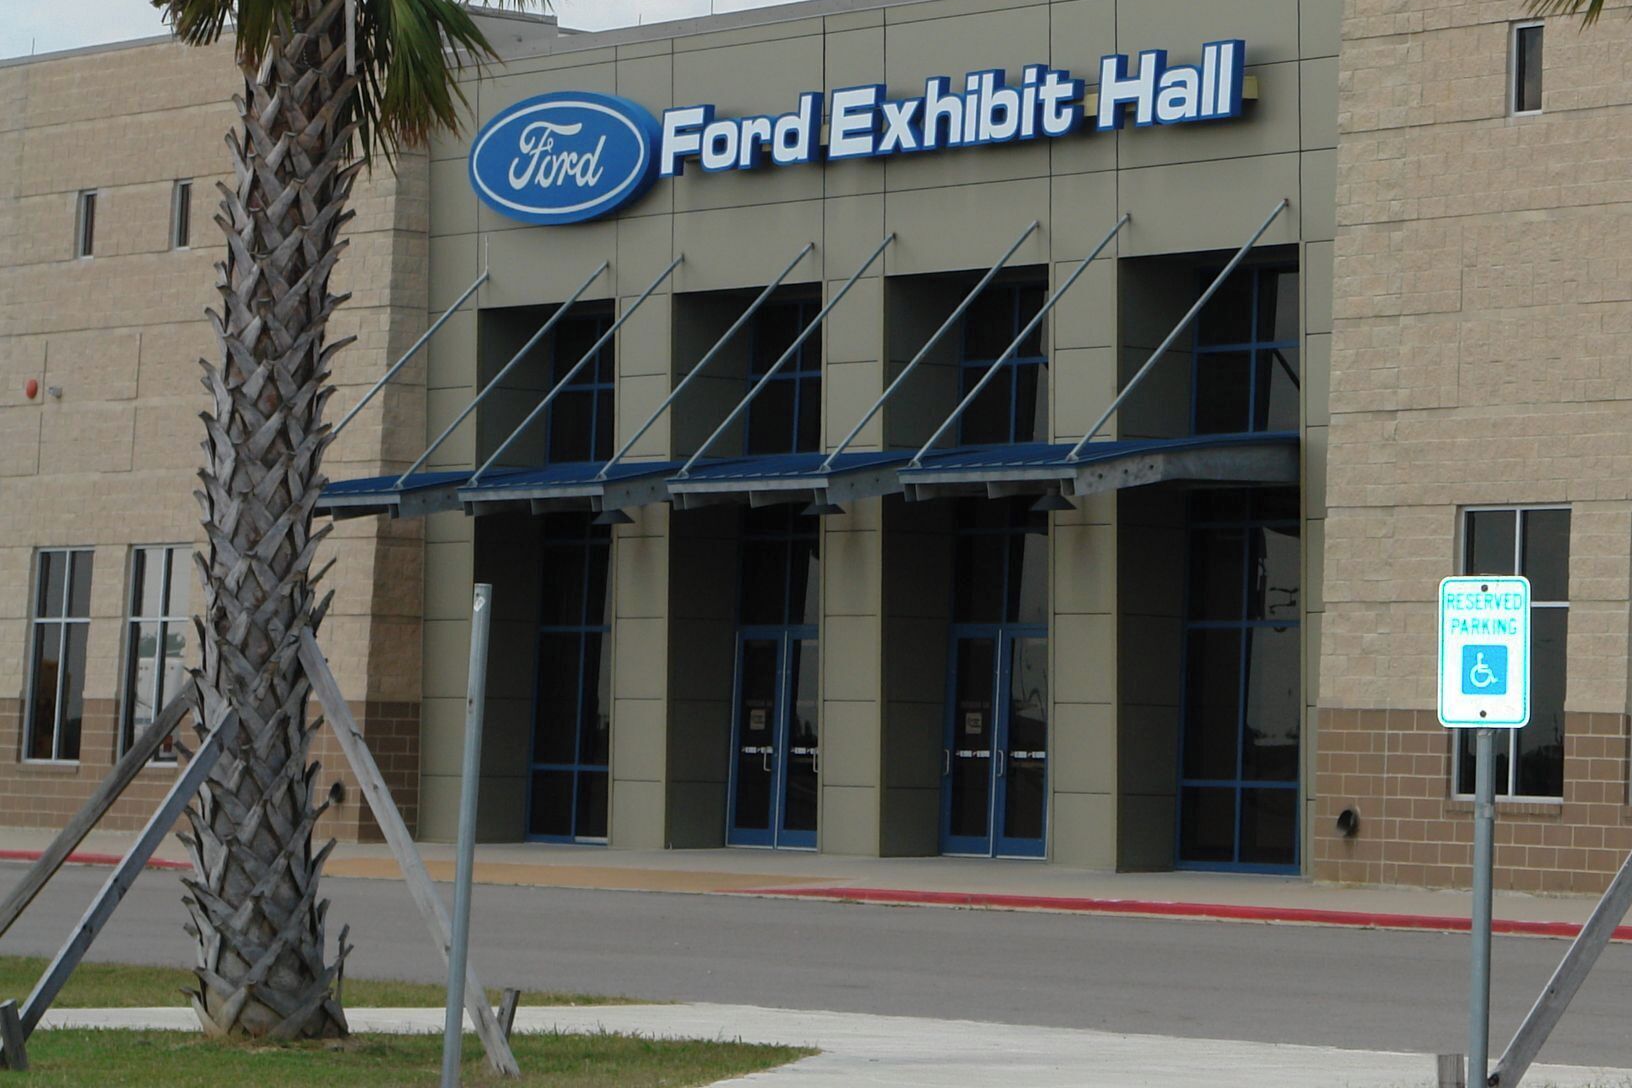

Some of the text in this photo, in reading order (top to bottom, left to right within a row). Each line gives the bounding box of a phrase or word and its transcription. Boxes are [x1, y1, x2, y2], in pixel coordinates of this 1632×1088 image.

[660, 40, 1244, 178] Ford Exhibit Hall
[508, 119, 605, 190] Ford
[1446, 593, 1523, 611] RESERVED
[1450, 618, 1518, 635] PARKING
